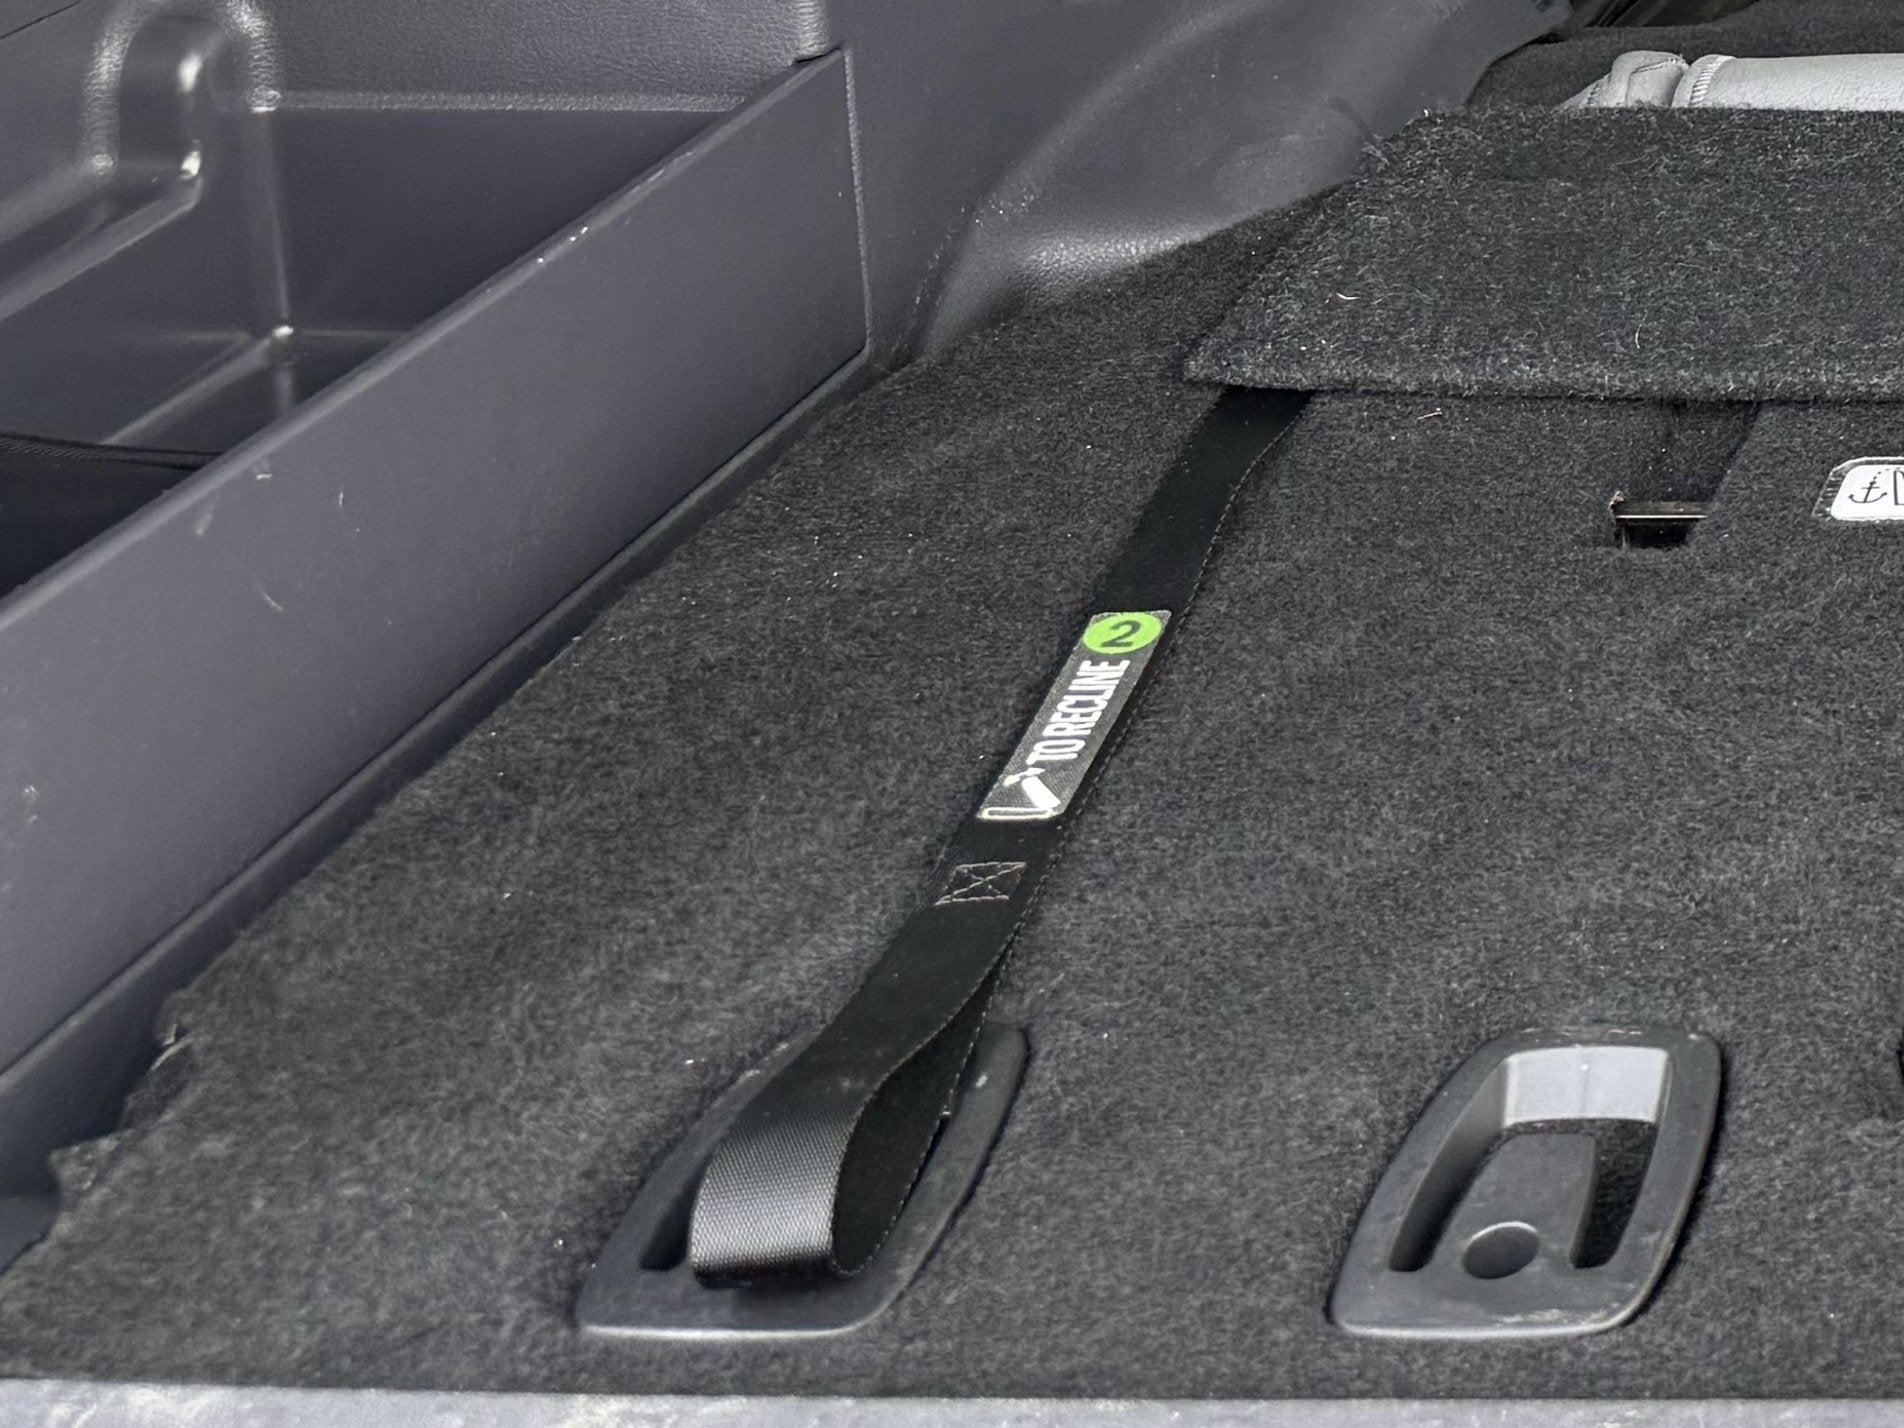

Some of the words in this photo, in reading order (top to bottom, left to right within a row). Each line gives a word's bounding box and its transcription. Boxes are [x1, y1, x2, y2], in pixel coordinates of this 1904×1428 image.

[1100, 619, 1143, 648] 2
[1044, 658, 1132, 742] RECLINE
[1031, 734, 1086, 761] TO
